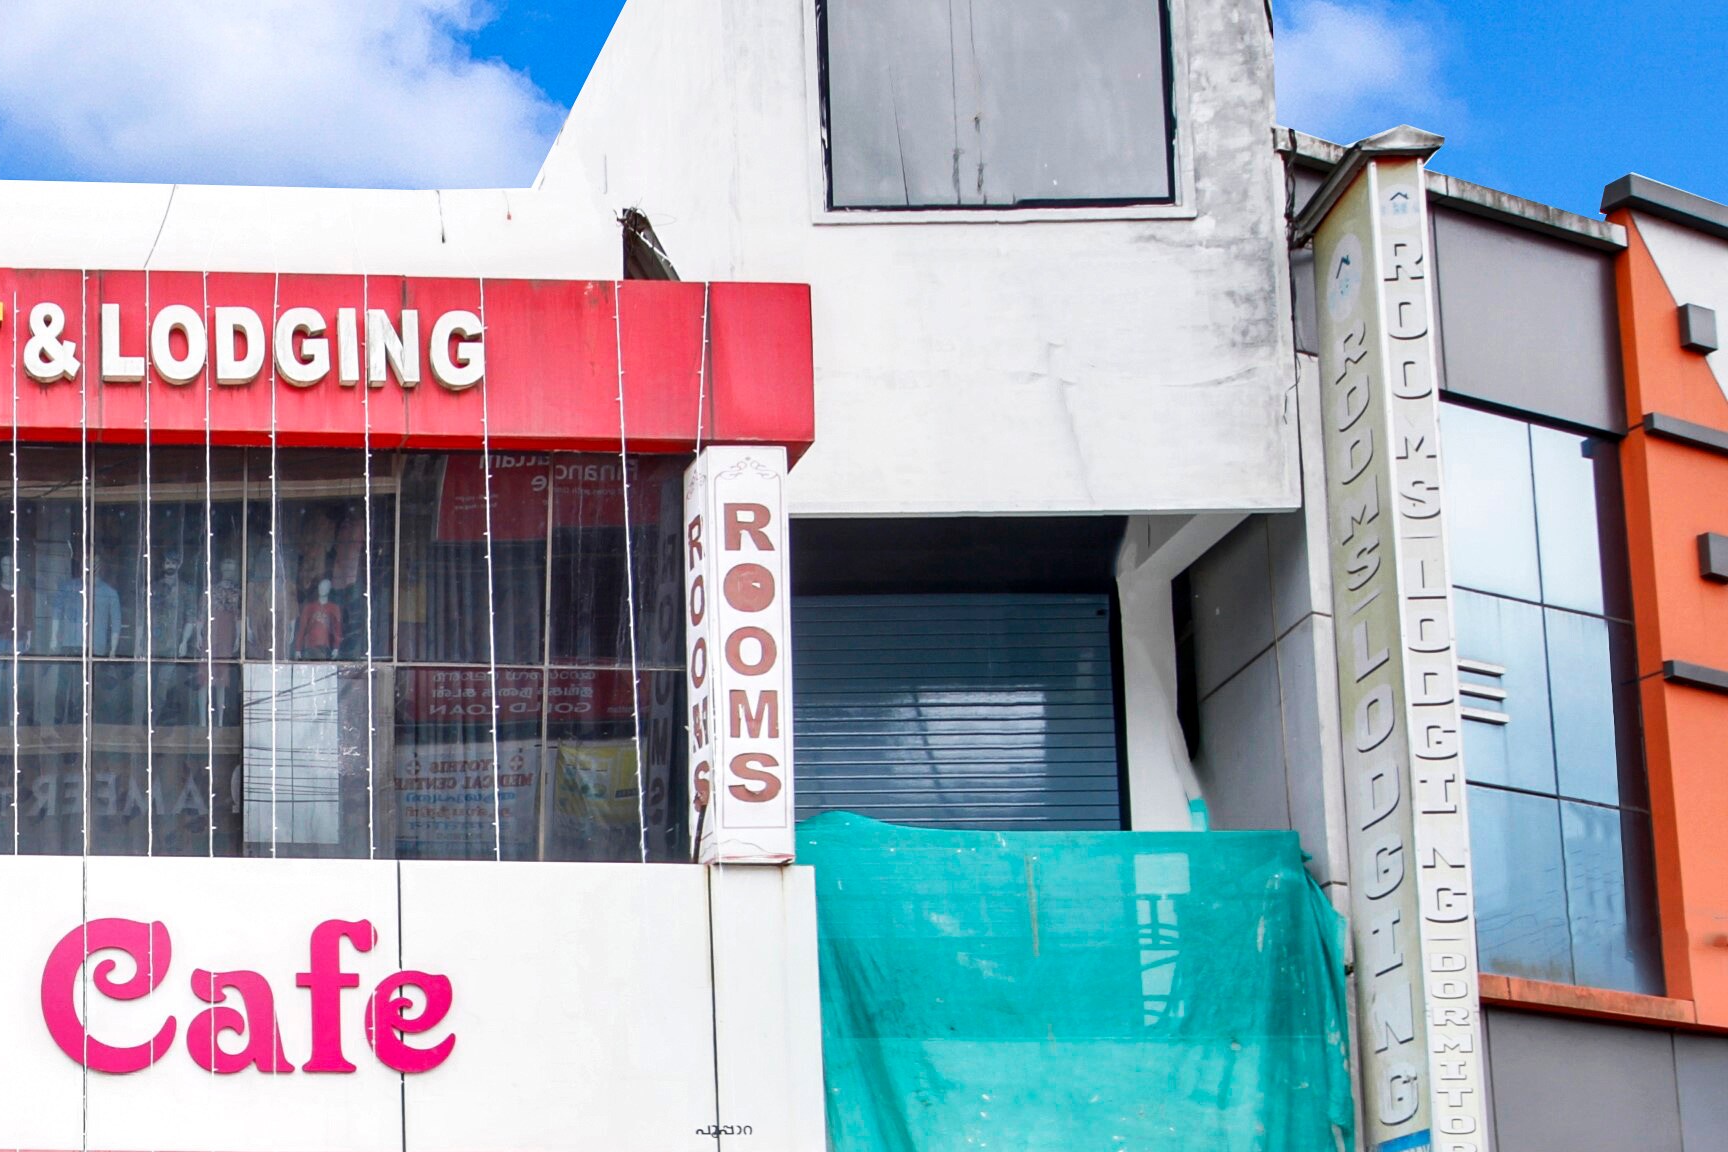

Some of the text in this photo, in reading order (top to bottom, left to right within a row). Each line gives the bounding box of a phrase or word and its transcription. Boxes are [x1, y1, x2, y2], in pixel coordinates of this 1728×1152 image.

[24, 301, 81, 385] &
[101, 302, 487, 391] LODGING
[687, 513, 711, 812] ROOMS
[723, 501, 782, 803] ROOMS
[39, 915, 457, 1075] Cafe
